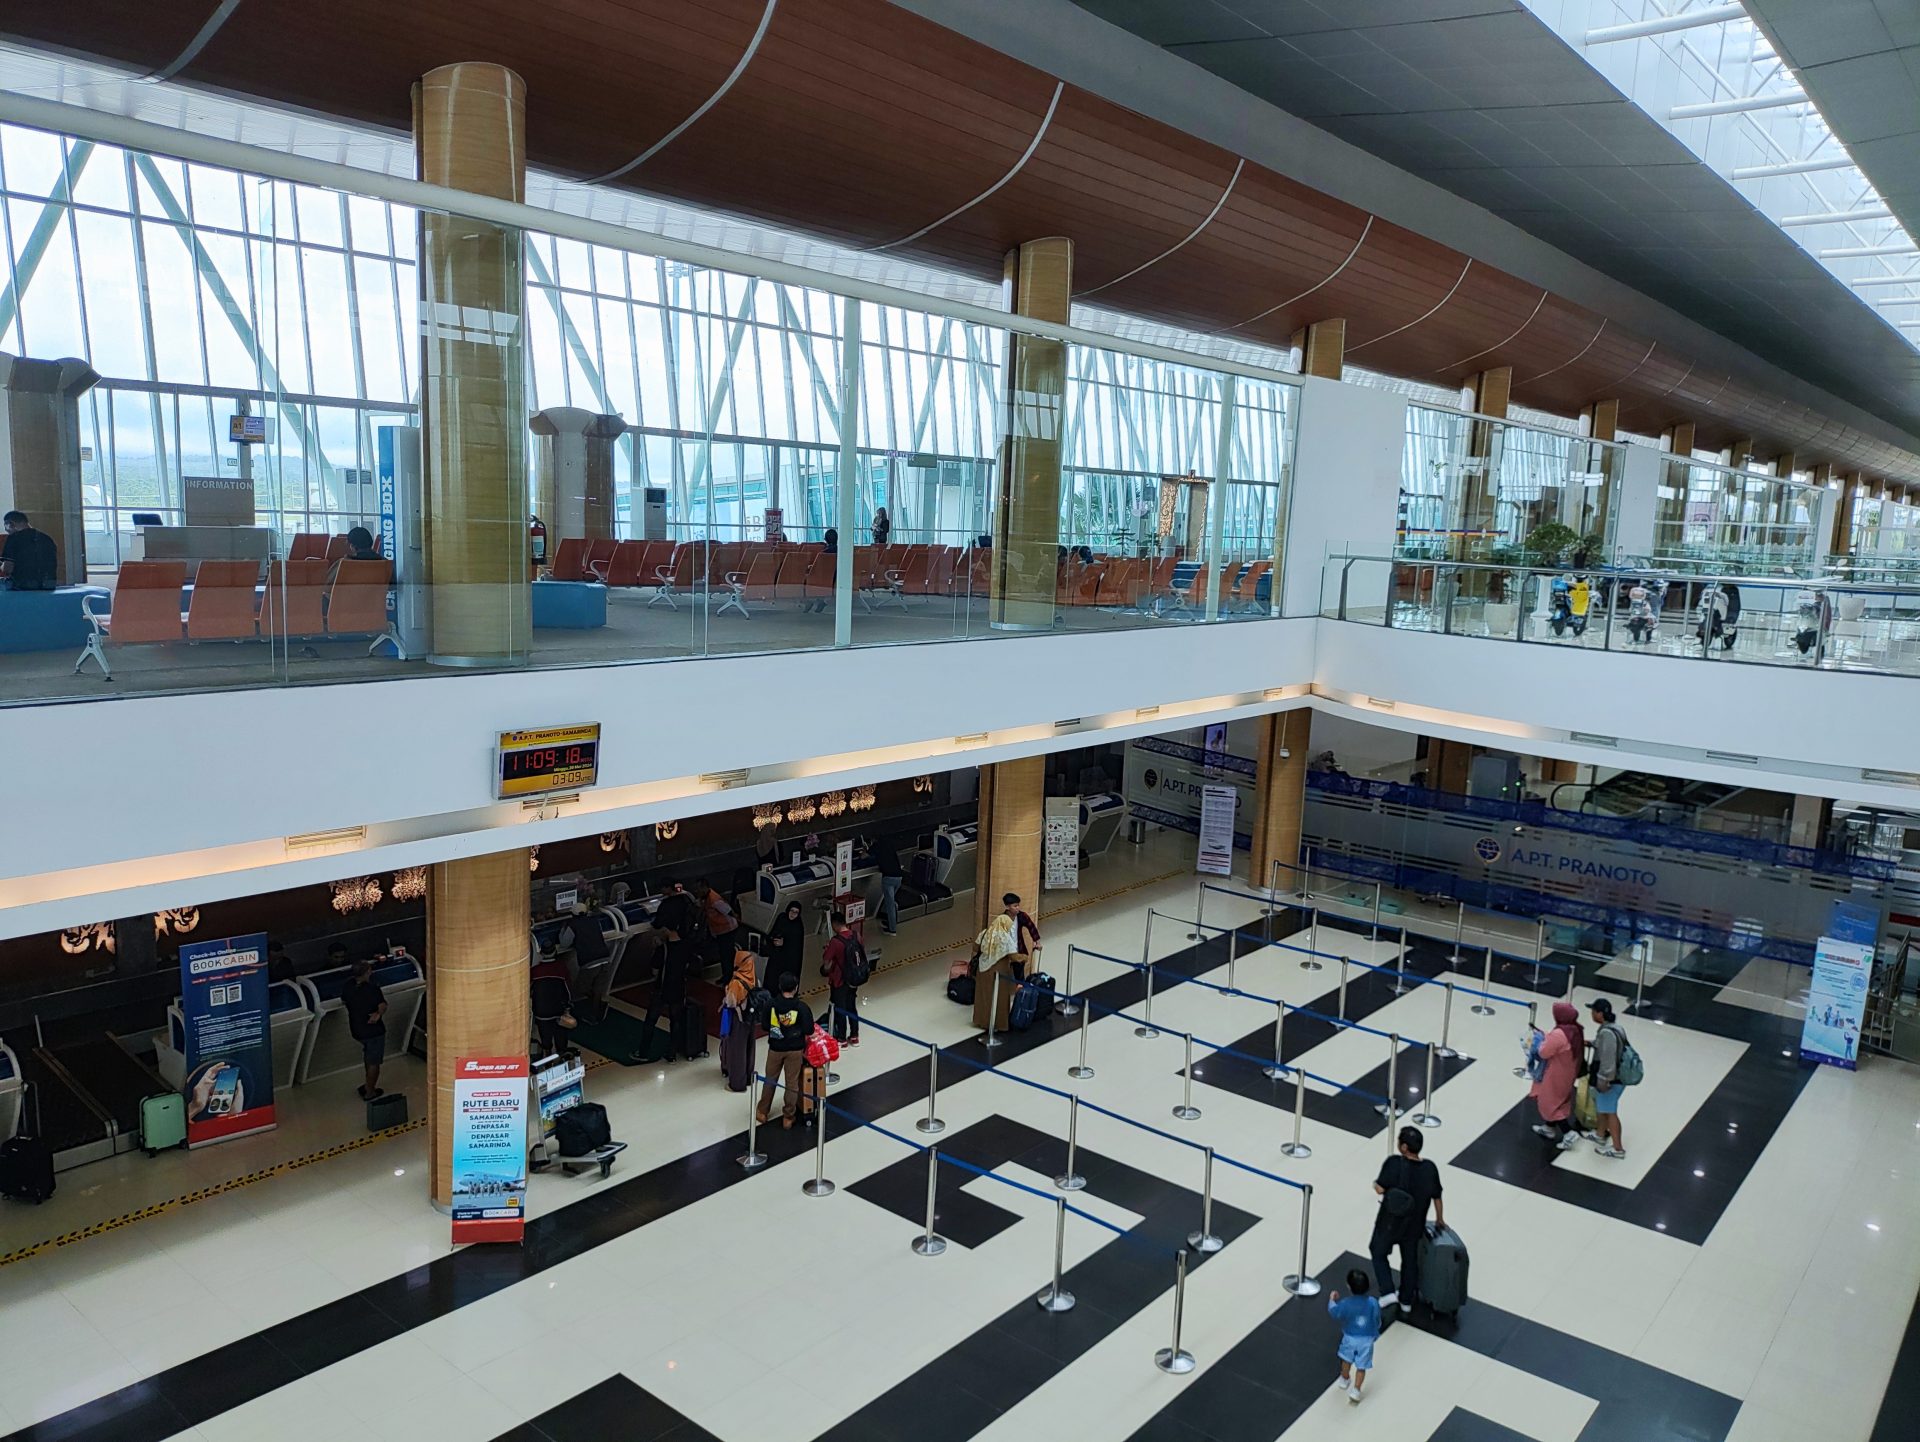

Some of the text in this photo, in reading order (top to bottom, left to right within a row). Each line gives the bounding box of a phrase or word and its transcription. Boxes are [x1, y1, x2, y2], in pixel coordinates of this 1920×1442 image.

[185, 479, 253, 490] INFORMATION
[381, 475, 393, 515] BOX
[552, 771, 581, 785] 03:09
[1511, 849, 1555, 870] A.P.T.
[1558, 856, 1657, 887] PRANOTO
[190, 951, 216, 961] Check-in
[193, 953, 256, 971] BOOKCABIN
[464, 1060, 494, 1072] SUPER
[462, 1099, 520, 1108] RUTE BARU
[469, 1113, 513, 1121] SAMARINDA
[471, 1132, 510, 1140] DENPASAR
[56, 1203, 164, 1247] BATAS ANTRIAN
